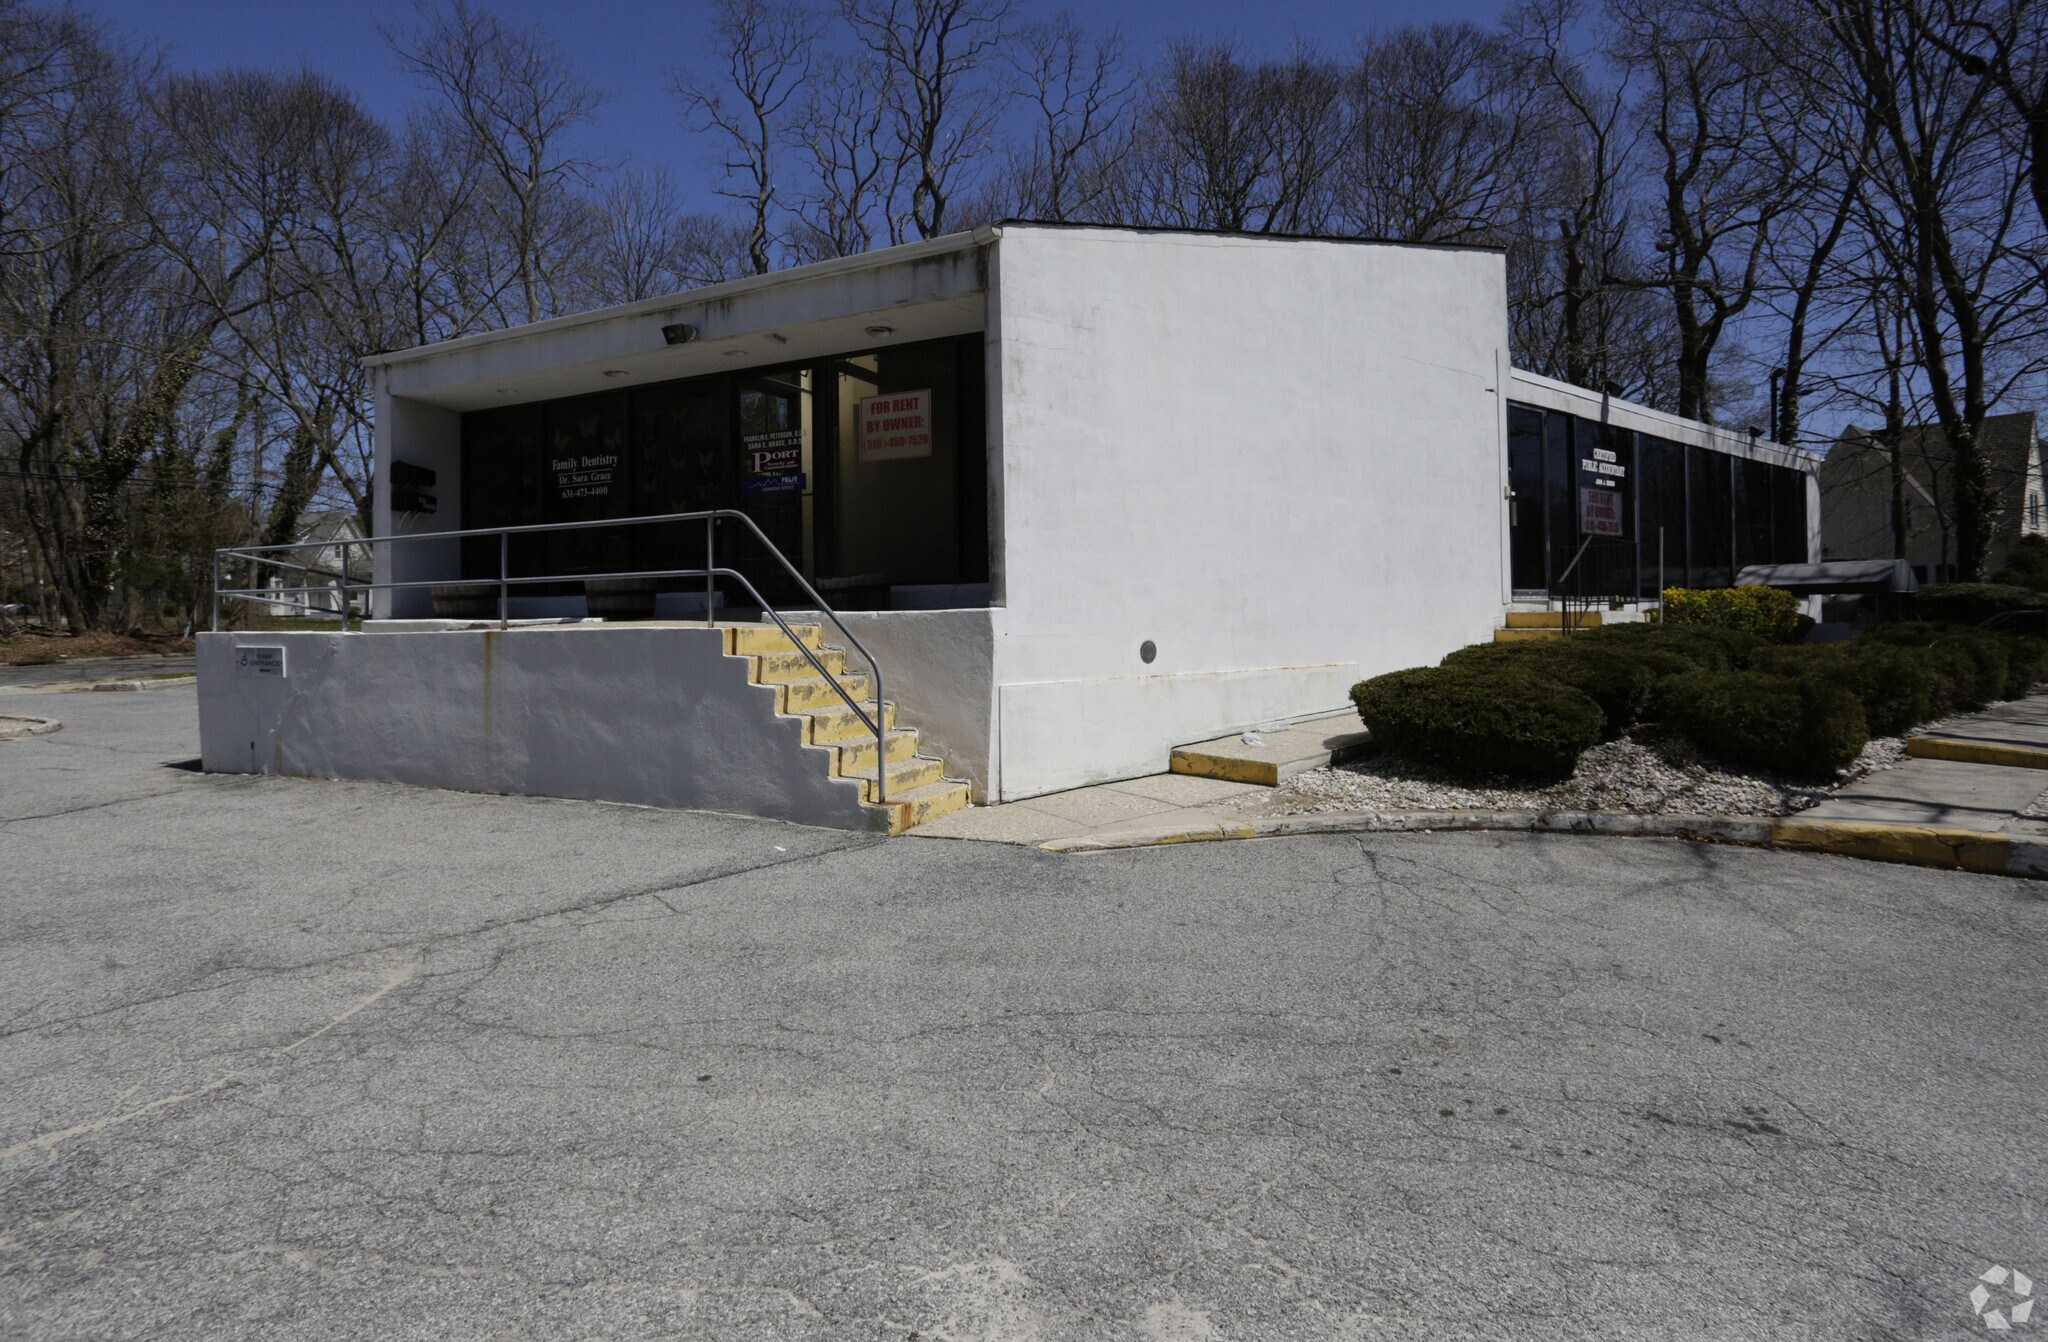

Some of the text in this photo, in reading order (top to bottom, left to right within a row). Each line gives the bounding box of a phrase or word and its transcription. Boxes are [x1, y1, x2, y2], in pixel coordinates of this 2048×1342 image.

[871, 397, 919, 415] FOR RENT
[866, 416, 925, 433] BY OWNER:
[747, 441, 762, 450] SARA
[552, 455, 618, 471] Family Dentistry
[751, 449, 799, 473] PORT
[1581, 458, 1598, 473] PUBLIC
[559, 472, 612, 485] Dr. Sara Grace
[562, 486, 608, 498] 631-473-4400
